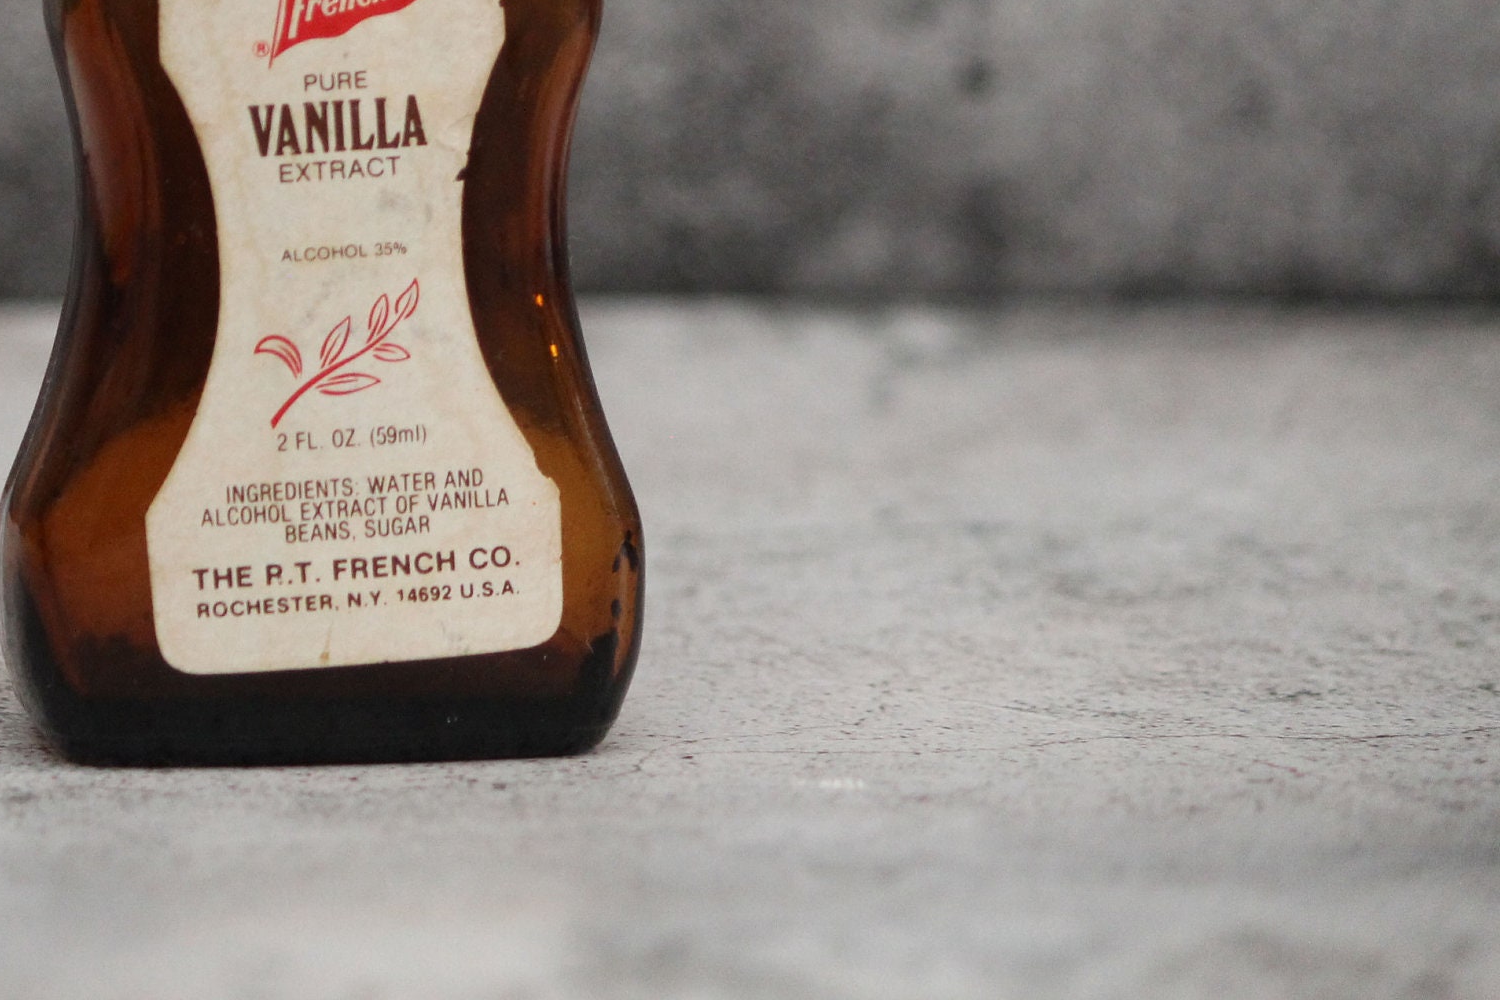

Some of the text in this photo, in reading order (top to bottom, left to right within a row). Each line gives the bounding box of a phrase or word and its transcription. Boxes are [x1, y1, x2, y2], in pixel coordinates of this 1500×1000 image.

[304, 70, 368, 92] PURE
[248, 94, 428, 157] VANILLA
[279, 156, 401, 183] EXTRACT
[281, 241, 408, 262] ALCOHOL 35%
[277, 424, 427, 451] 2 FL. OZ. (59ml)
[226, 468, 484, 505] INGREDIENTS: WATER AND
[201, 488, 509, 527] ALCOHOL EXTRACT OF VANILLA
[284, 515, 431, 544] BEANS, SUGAR
[192, 546, 521, 591] THE R.T. FRENCH CO.
[197, 580, 520, 619] ROCHESTER, N.Y. 14692 U.S.A.
